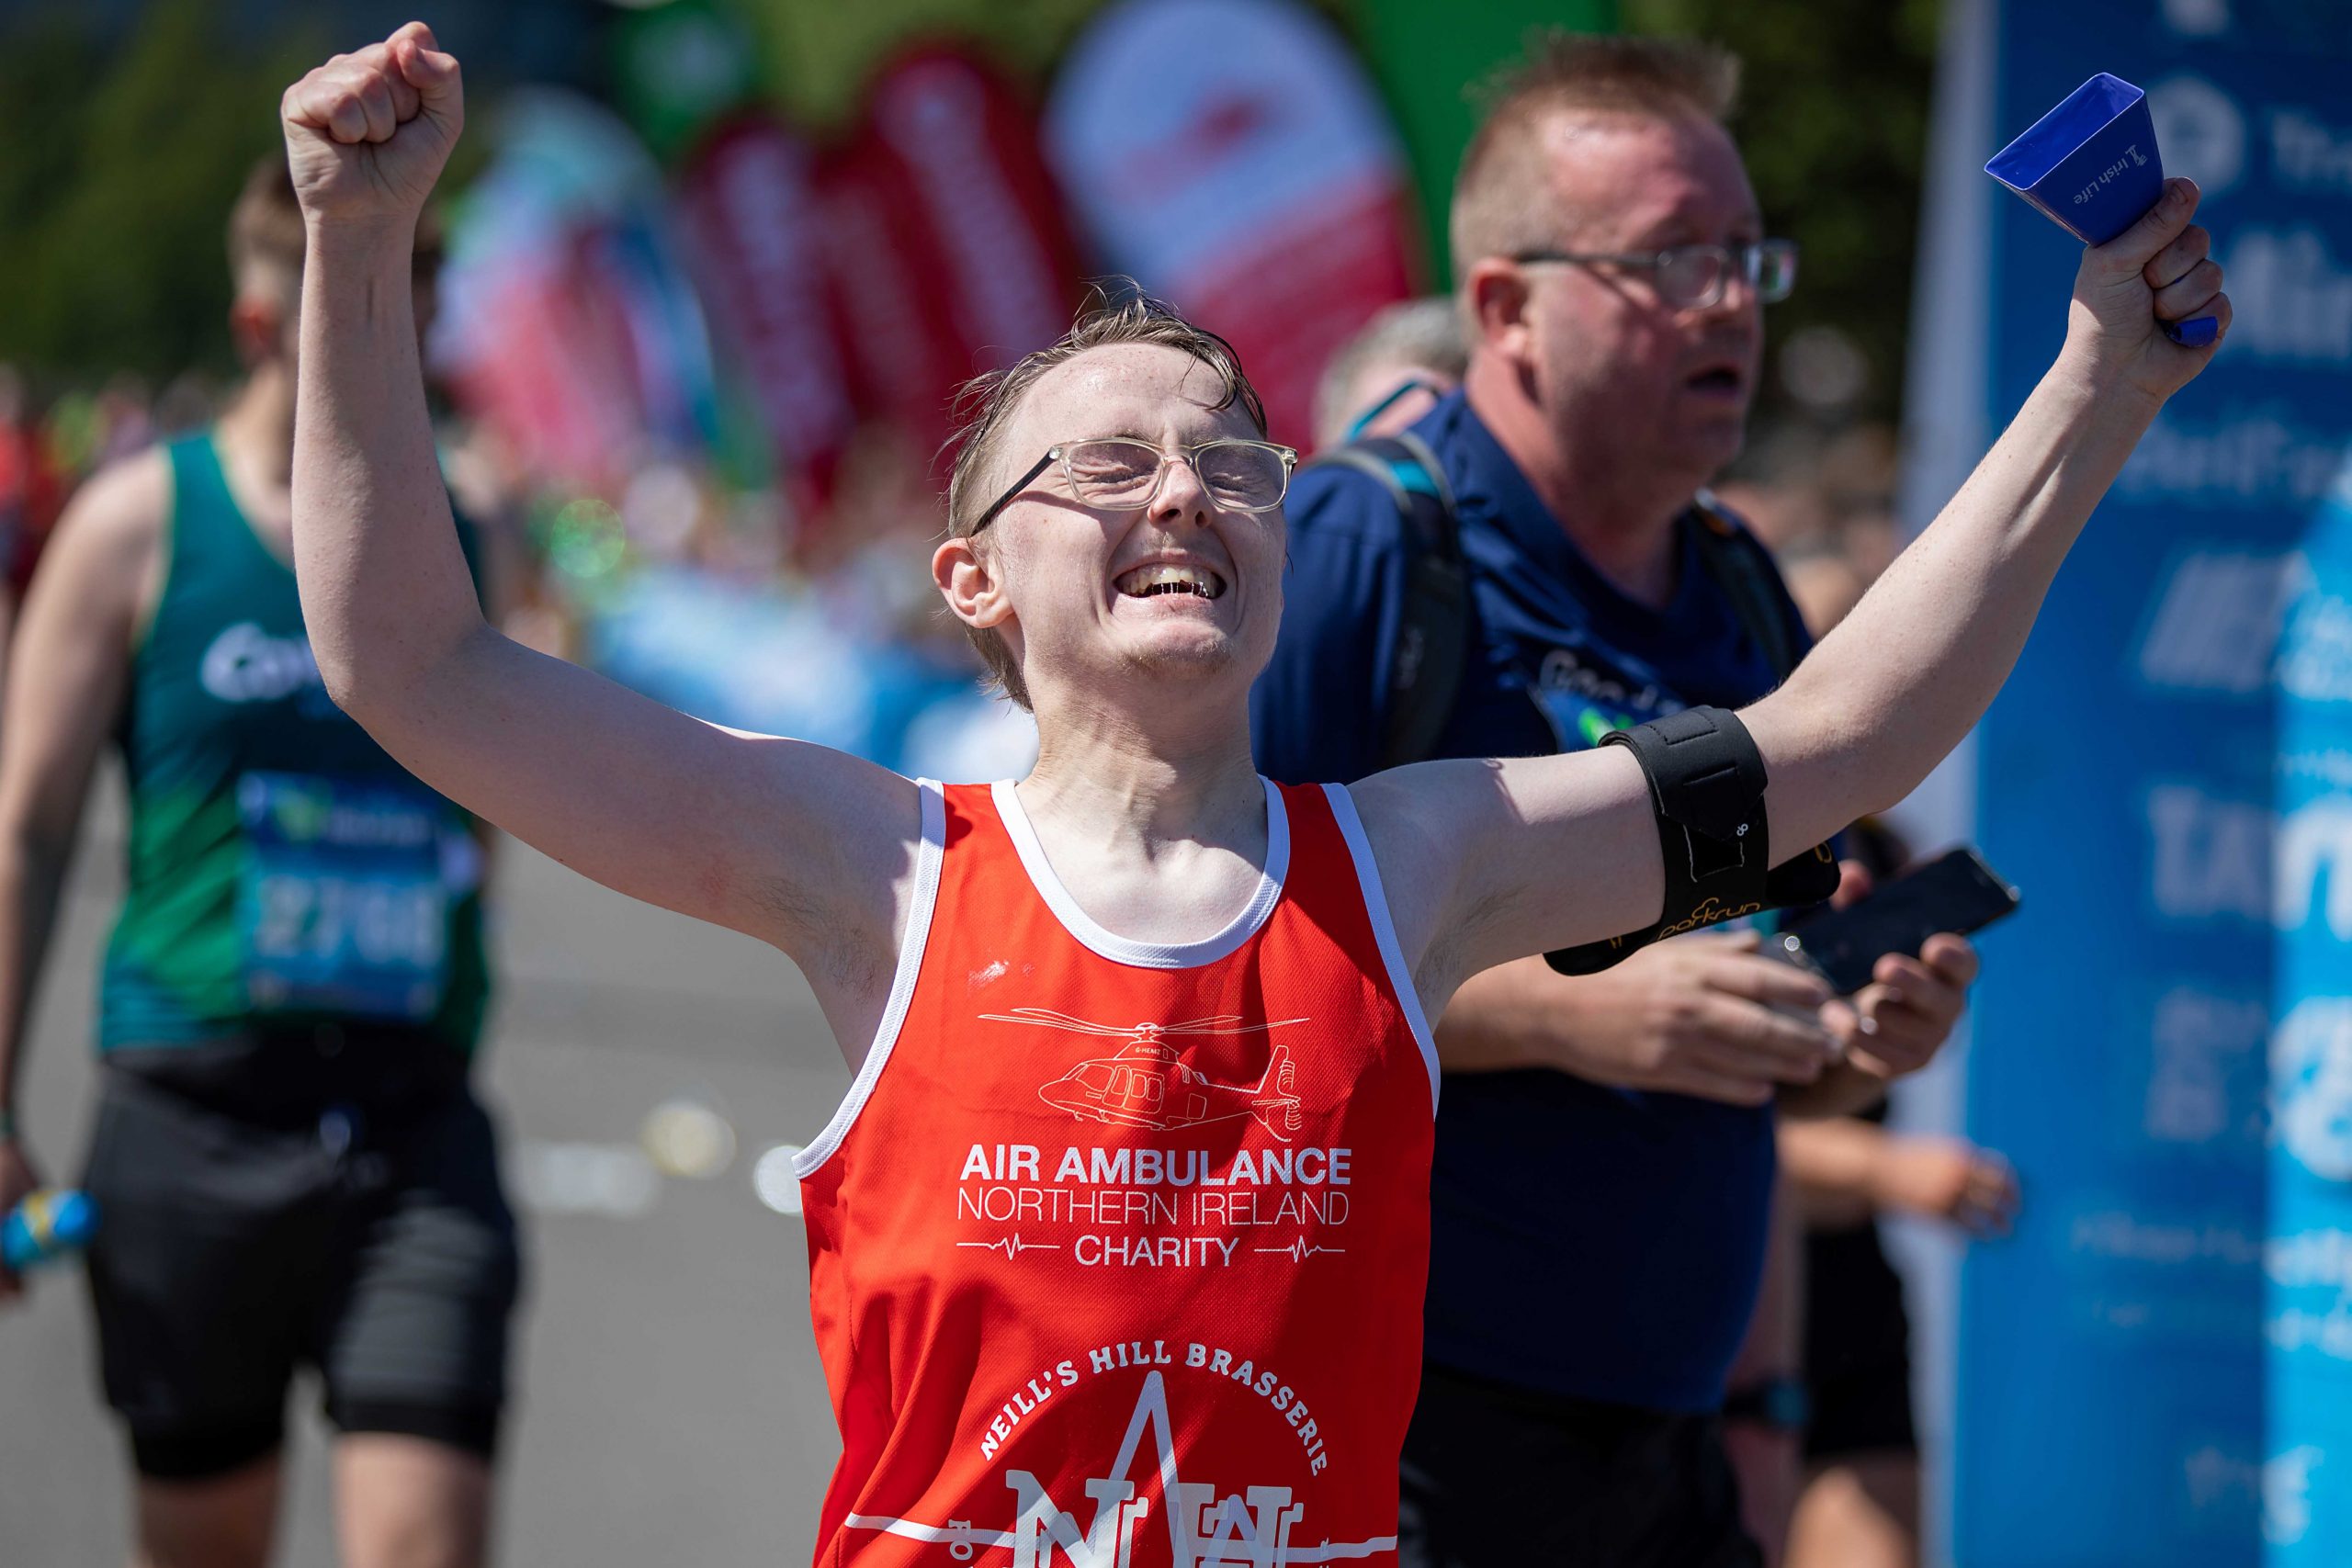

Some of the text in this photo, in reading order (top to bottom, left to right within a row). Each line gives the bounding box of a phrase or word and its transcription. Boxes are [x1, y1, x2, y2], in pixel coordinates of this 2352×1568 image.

[2073, 158, 2129, 204] Irish Life
[1657, 897, 1760, 942] parkrun
[959, 1144, 1352, 1187] AIR AMBULANCE
[957, 1186, 1349, 1225] NORTHERN IRELAND
[1074, 1235, 1239, 1267] CHARITY
[980, 1339, 1328, 1477] NEILL'S HILL BRASSERIE
